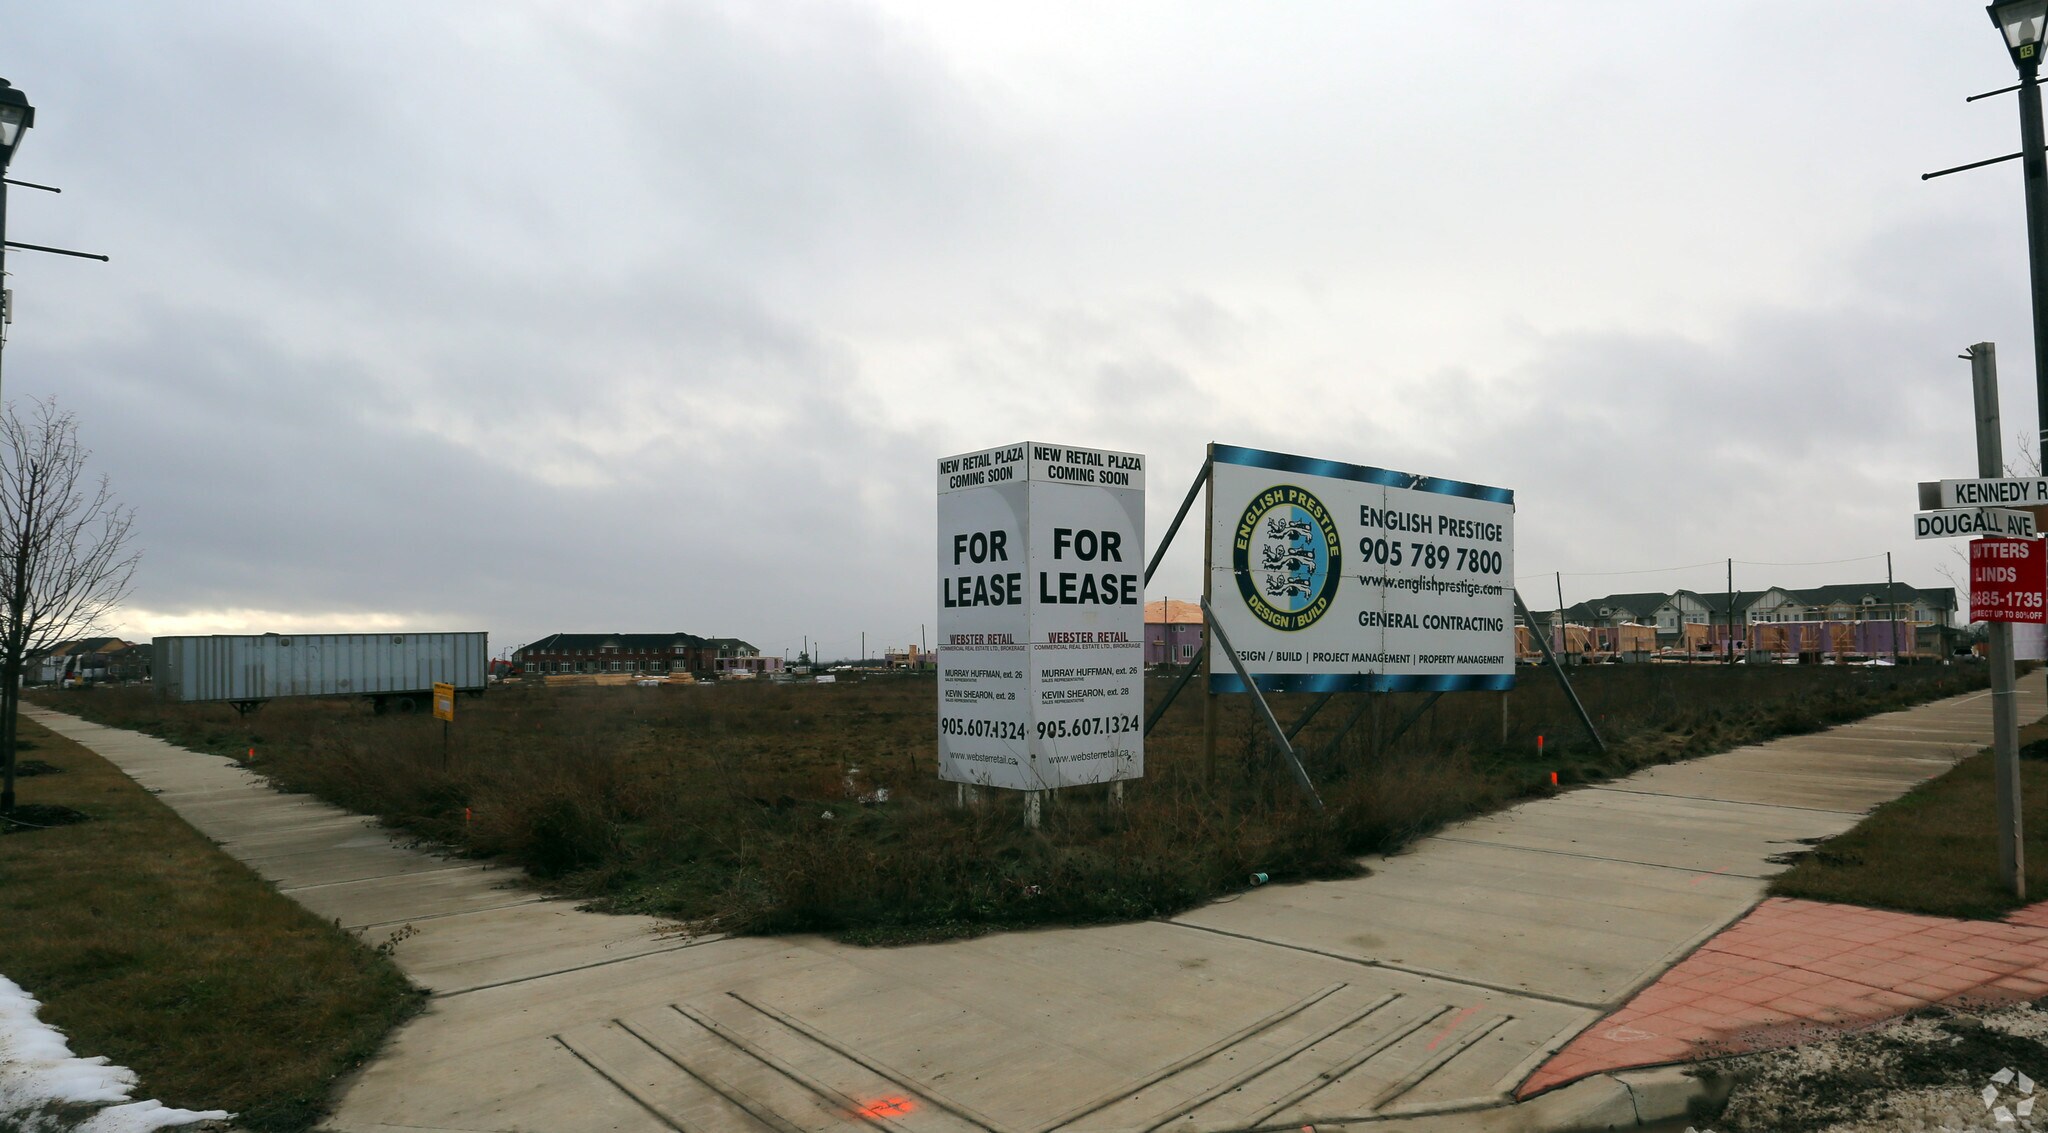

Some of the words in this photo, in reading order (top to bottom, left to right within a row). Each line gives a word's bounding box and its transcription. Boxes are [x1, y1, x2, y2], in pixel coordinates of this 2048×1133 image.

[2022, 46, 2032, 56] 15
[940, 460, 959, 474] NEW
[963, 454, 992, 470] RETAIL
[995, 447, 1024, 464] PLAZA
[1034, 447, 1061, 462] NEW
[1067, 449, 1104, 467] RETAIL
[1108, 455, 1142, 471] PLAZA
[950, 471, 984, 489] COMING
[988, 466, 1013, 483] SOON
[1048, 465, 1094, 482] COMING
[1100, 470, 1129, 485] SOON
[1956, 481, 2030, 504] KENNEDY
[1237, 489, 1284, 550] ENGLISH
[1289, 489, 1339, 557] PRESTIGE
[1360, 504, 1432, 534] ENGLISH
[1439, 515, 1502, 542] PRESTIGE
[1918, 512, 2002, 536] DOUGALL
[2008, 515, 2033, 537] AVE
[954, 530, 1008, 565] FOR
[1054, 527, 1122, 562] FOR
[1360, 537, 1402, 566] 905
[1411, 543, 1450, 569] 789
[1456, 548, 1502, 575] 7800
[1973, 542, 2029, 559] UTTERS
[1360, 574, 1502, 597] www.englishprestige.com
[1975, 566, 2016, 582] LINDS
[944, 573, 1022, 608] LEASE
[1040, 572, 1137, 604] LEASE
[1248, 594, 1289, 627] DESIGN
[1297, 597, 1327, 627] BUILD
[1359, 611, 1419, 629] GENERAL
[1423, 614, 1503, 631] CONTRACTING
[2005, 610, 2014, 618] TO
[950, 634, 984, 645] WEBSTER
[988, 633, 1014, 645] RETAIL
[1048, 632, 1093, 643] WEBSTER
[1098, 632, 1129, 642] RETAIL
[1276, 651, 1302, 662] BUILD
[1313, 652, 1349, 662] PROJECT
[1352, 653, 1410, 663] MANAGEMENT
[1419, 654, 1455, 663] PROPERTY
[1457, 655, 1504, 664] MANAGEMENT
[971, 670, 1001, 679] HUFFMAN,
[1042, 669, 1074, 677] MURRAY
[1077, 667, 1114, 676] HUFFMAN,
[945, 690, 962, 698] KEVIN
[964, 690, 994, 700] SHEARON,
[1008, 692, 1016, 700] 28
[1042, 691, 1064, 699] KEVIN
[1067, 689, 1105, 698] SHEARON,
[942, 717, 1025, 740] 905.607.1324
[1037, 715, 1139, 740] 905.607.1324
[950, 752, 1016, 765] www.websterretail.ca
[1049, 749, 1128, 764] www.websterretail.ca
